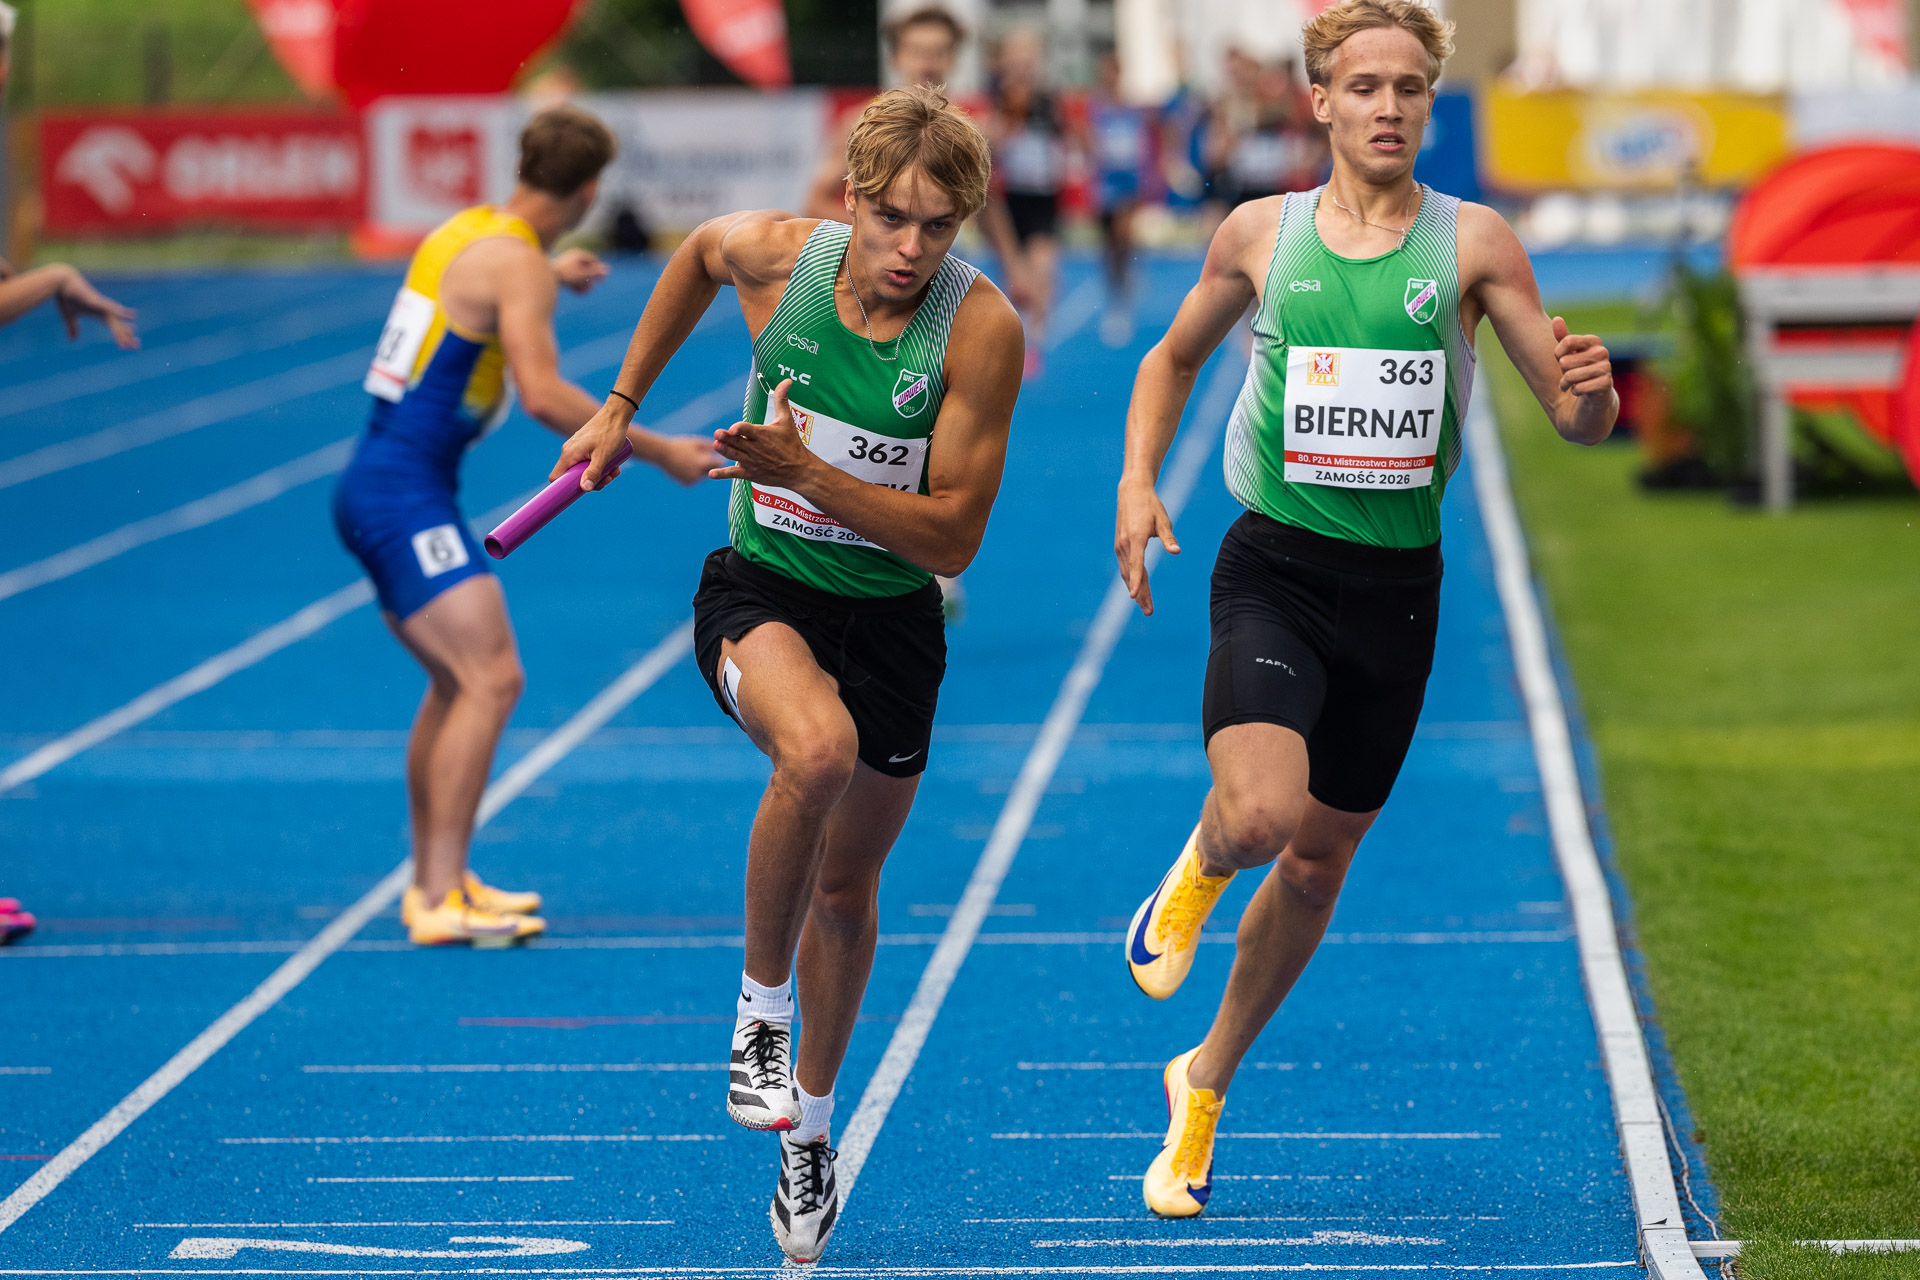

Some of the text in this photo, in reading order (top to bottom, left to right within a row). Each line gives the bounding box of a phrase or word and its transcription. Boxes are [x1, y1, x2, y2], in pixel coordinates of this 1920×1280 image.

[778, 363, 812, 386] TLC
[1308, 374, 1337, 385] PZLA
[1379, 358, 1434, 385] 363
[898, 379, 924, 406] WAWEL
[1294, 404, 1435, 439] BIERNAT
[848, 435, 909, 466] 362
[1297, 453, 1427, 468] 80. PZLA Mistrzostwa Polski U20
[1315, 469, 1411, 485] ZAMOŚĆ 2026
[758, 494, 773, 505] 80.
[774, 498, 794, 513] PZLA
[771, 513, 834, 538] ZAMOŚĆ
[168, 1236, 591, 1259] 2
